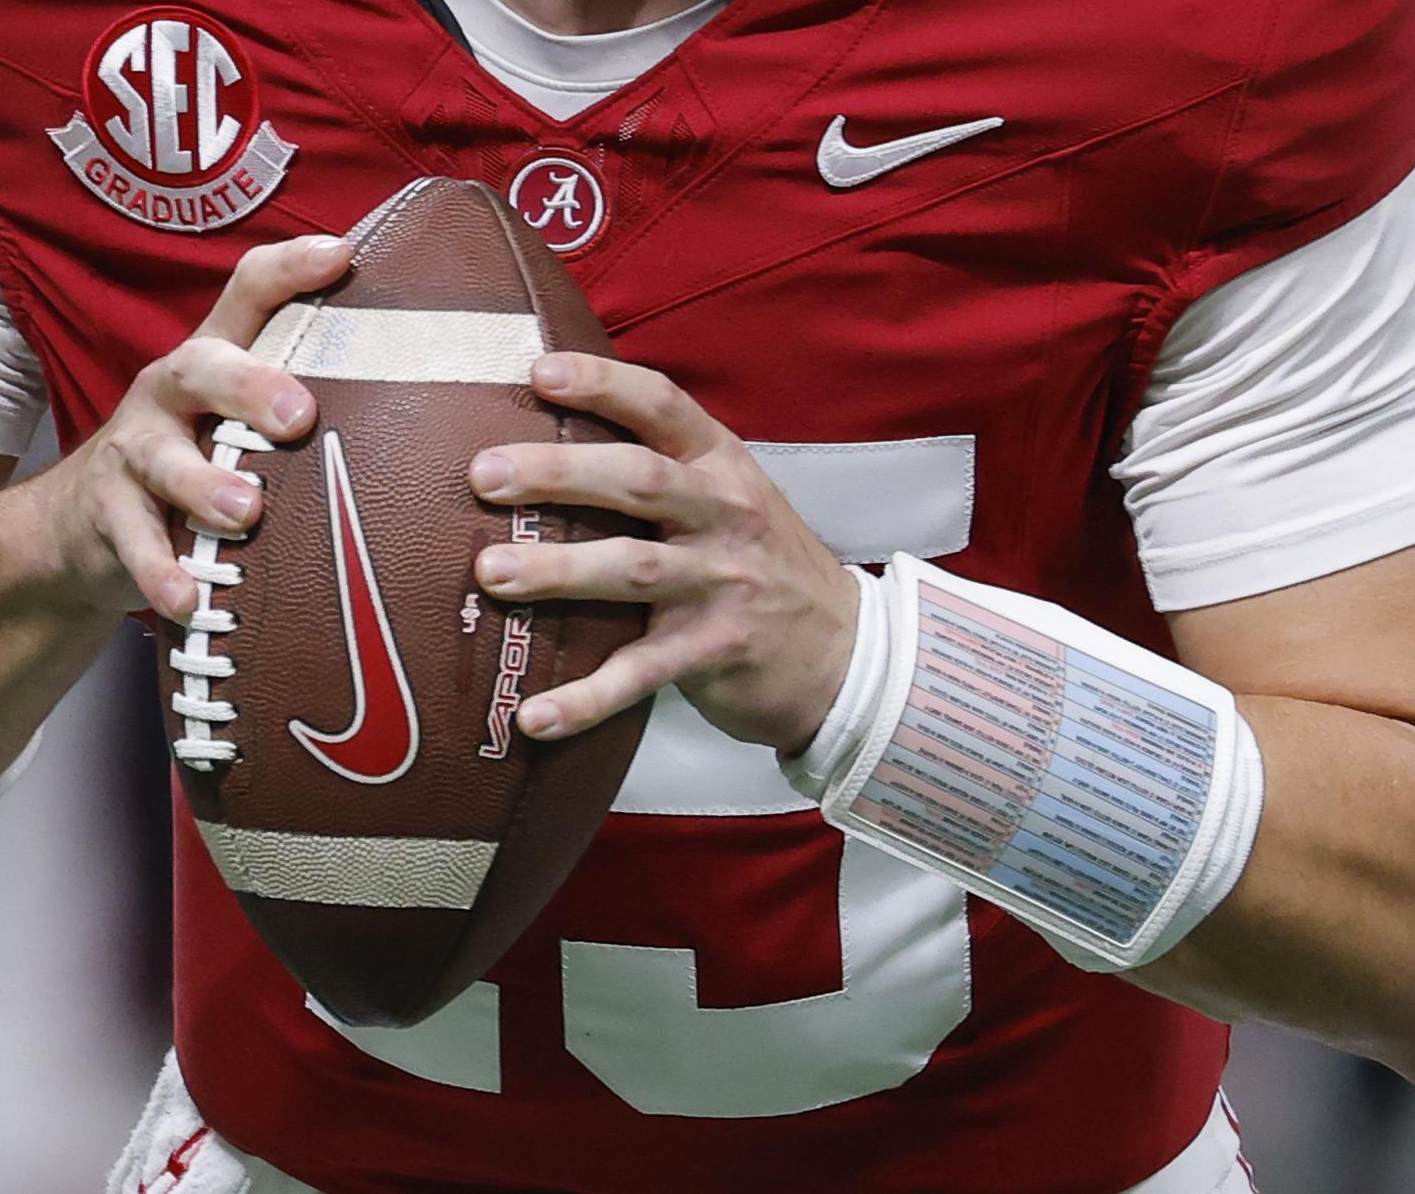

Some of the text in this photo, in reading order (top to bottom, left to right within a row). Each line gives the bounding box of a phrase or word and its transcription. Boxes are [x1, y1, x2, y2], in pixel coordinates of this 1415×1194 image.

[97, 19, 242, 174] SEC
[85, 157, 264, 226] GRADUATE
[523, 171, 584, 229] A
[478, 607, 534, 759] VAPOR
